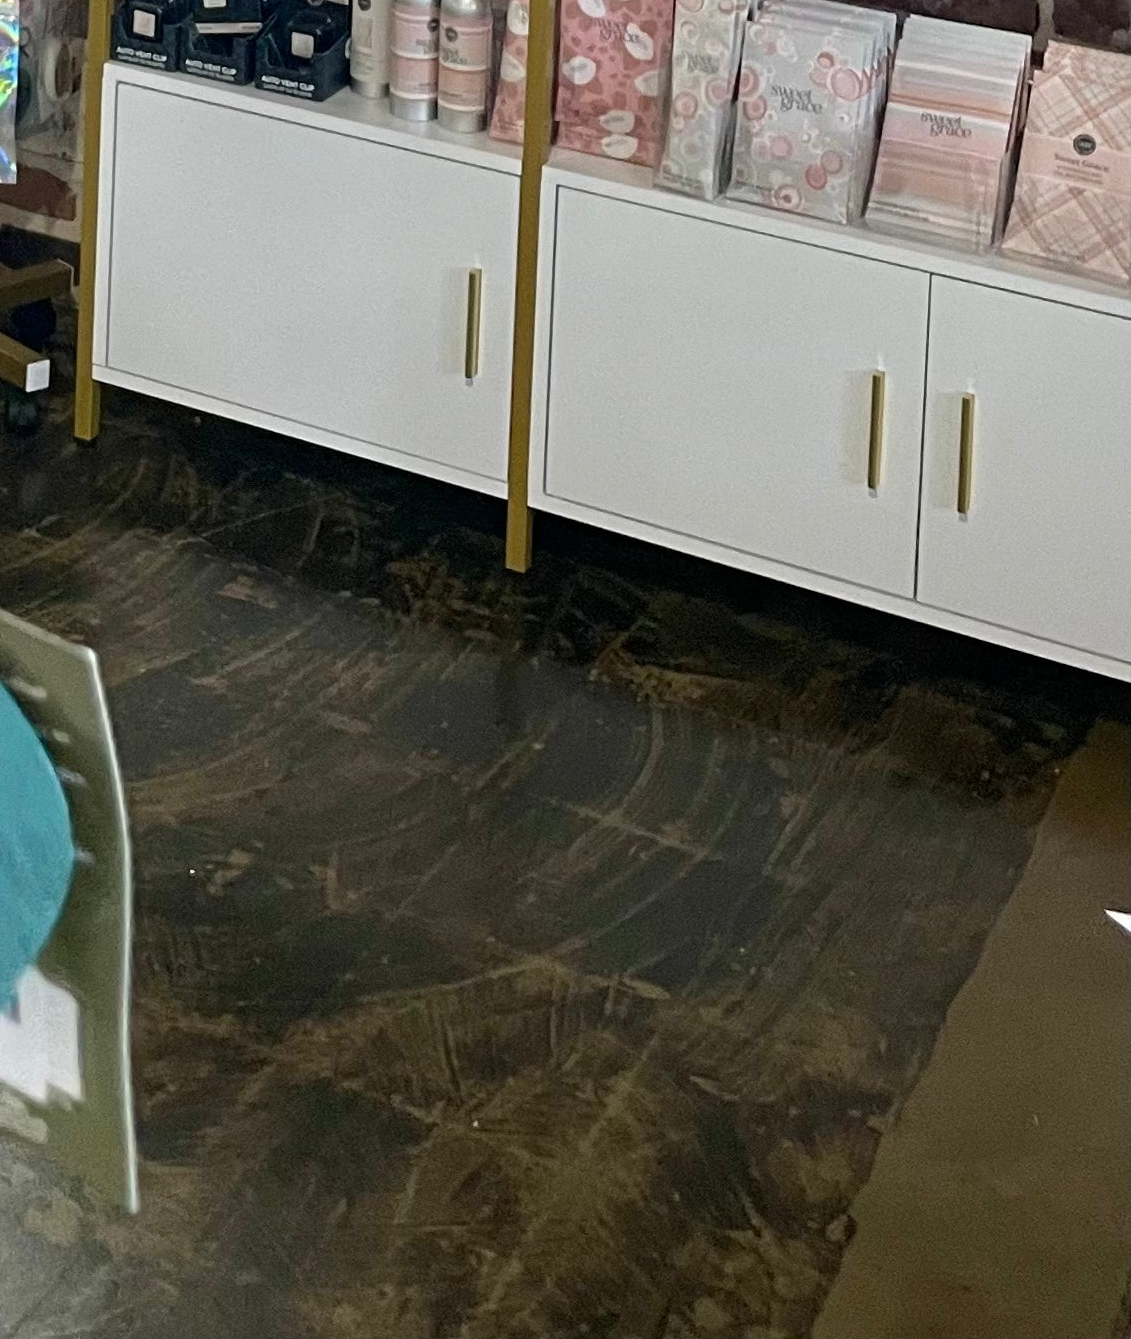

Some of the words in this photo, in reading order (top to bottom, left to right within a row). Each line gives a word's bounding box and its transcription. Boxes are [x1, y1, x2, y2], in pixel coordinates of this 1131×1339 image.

[771, 84, 812, 102] sweet
[779, 96, 823, 115] grace
[920, 111, 962, 128] sweet
[930, 123, 972, 139] grace
